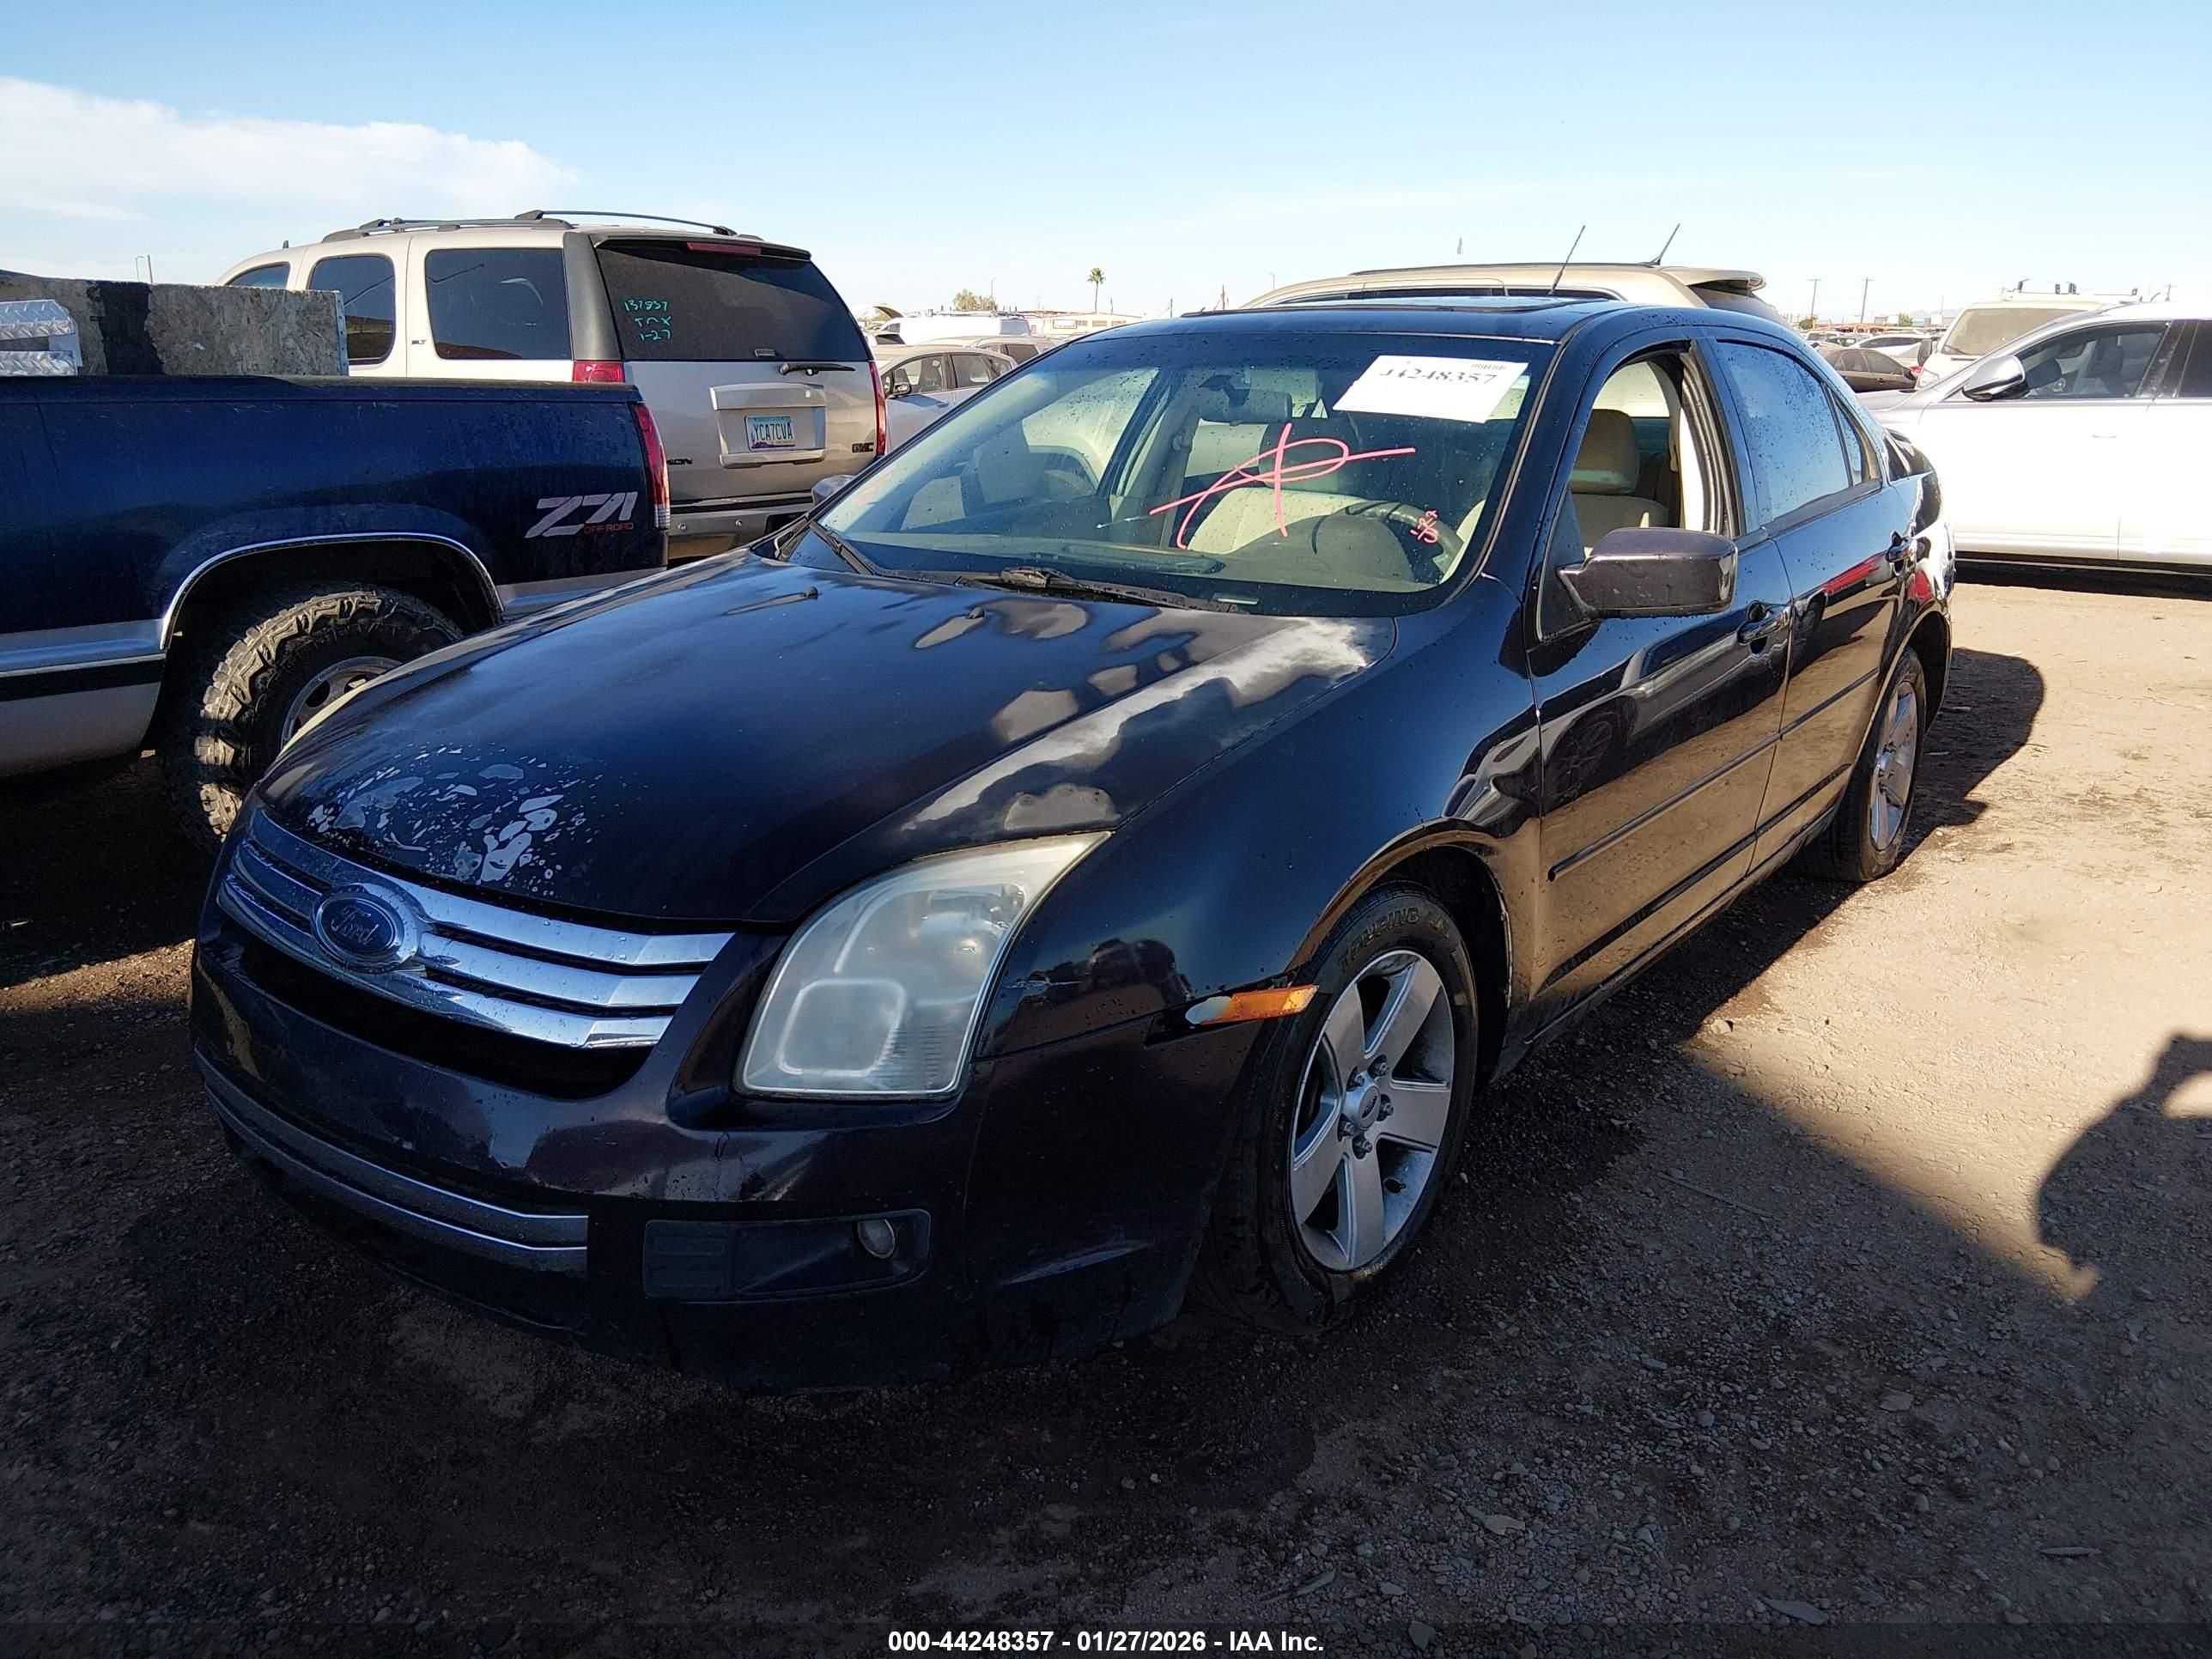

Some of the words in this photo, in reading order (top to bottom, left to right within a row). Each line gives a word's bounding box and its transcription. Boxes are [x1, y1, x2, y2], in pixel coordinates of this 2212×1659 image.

[640, 329, 671, 341] 1-27
[852, 442, 874, 453] GMC
[525, 491, 638, 538] Z71
[584, 525, 605, 534] OFF
[605, 522, 634, 532] ROAD
